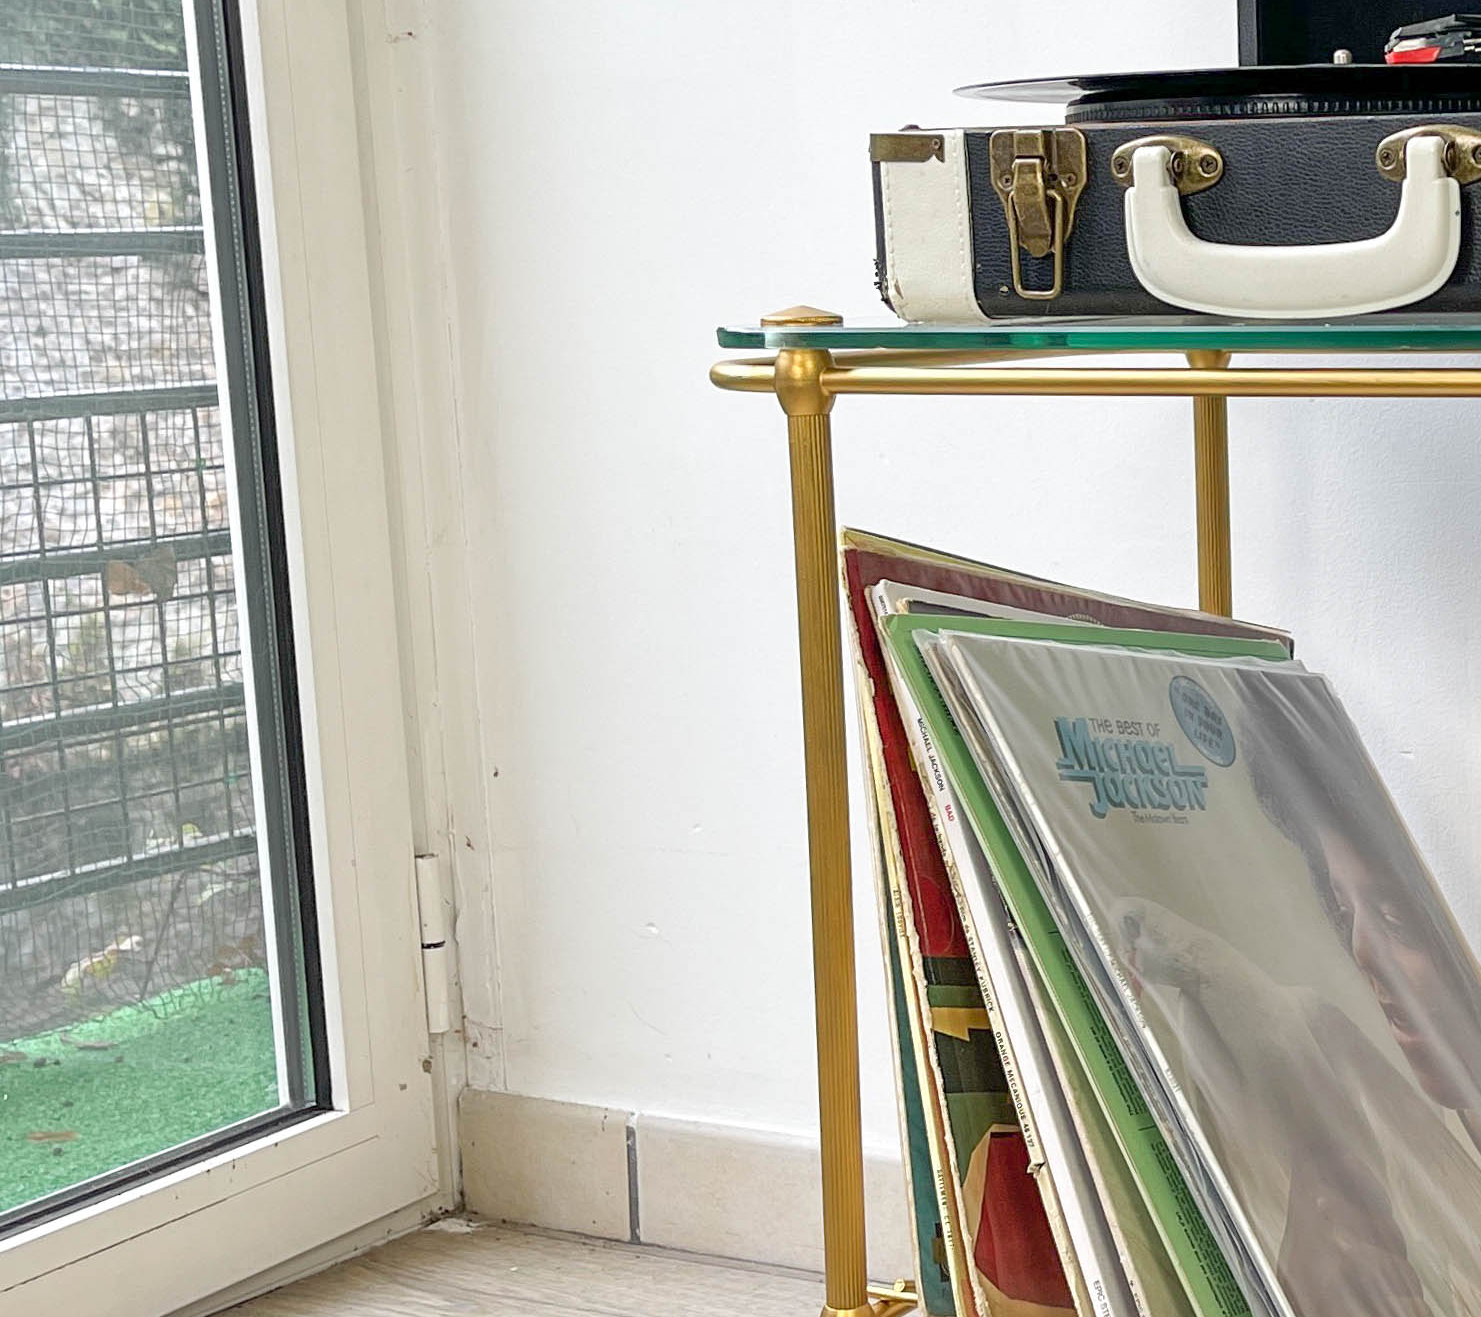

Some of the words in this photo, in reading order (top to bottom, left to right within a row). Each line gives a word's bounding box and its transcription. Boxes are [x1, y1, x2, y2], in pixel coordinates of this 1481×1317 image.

[917, 717, 931, 754] MICHAEL
[928, 754, 945, 792] JACKSON
[944, 804, 956, 822] BAD
[979, 976, 995, 1013] KUBRICK
[995, 1031, 1011, 1066] ORANGE
[1093, 1279, 1105, 1302] EPIC
